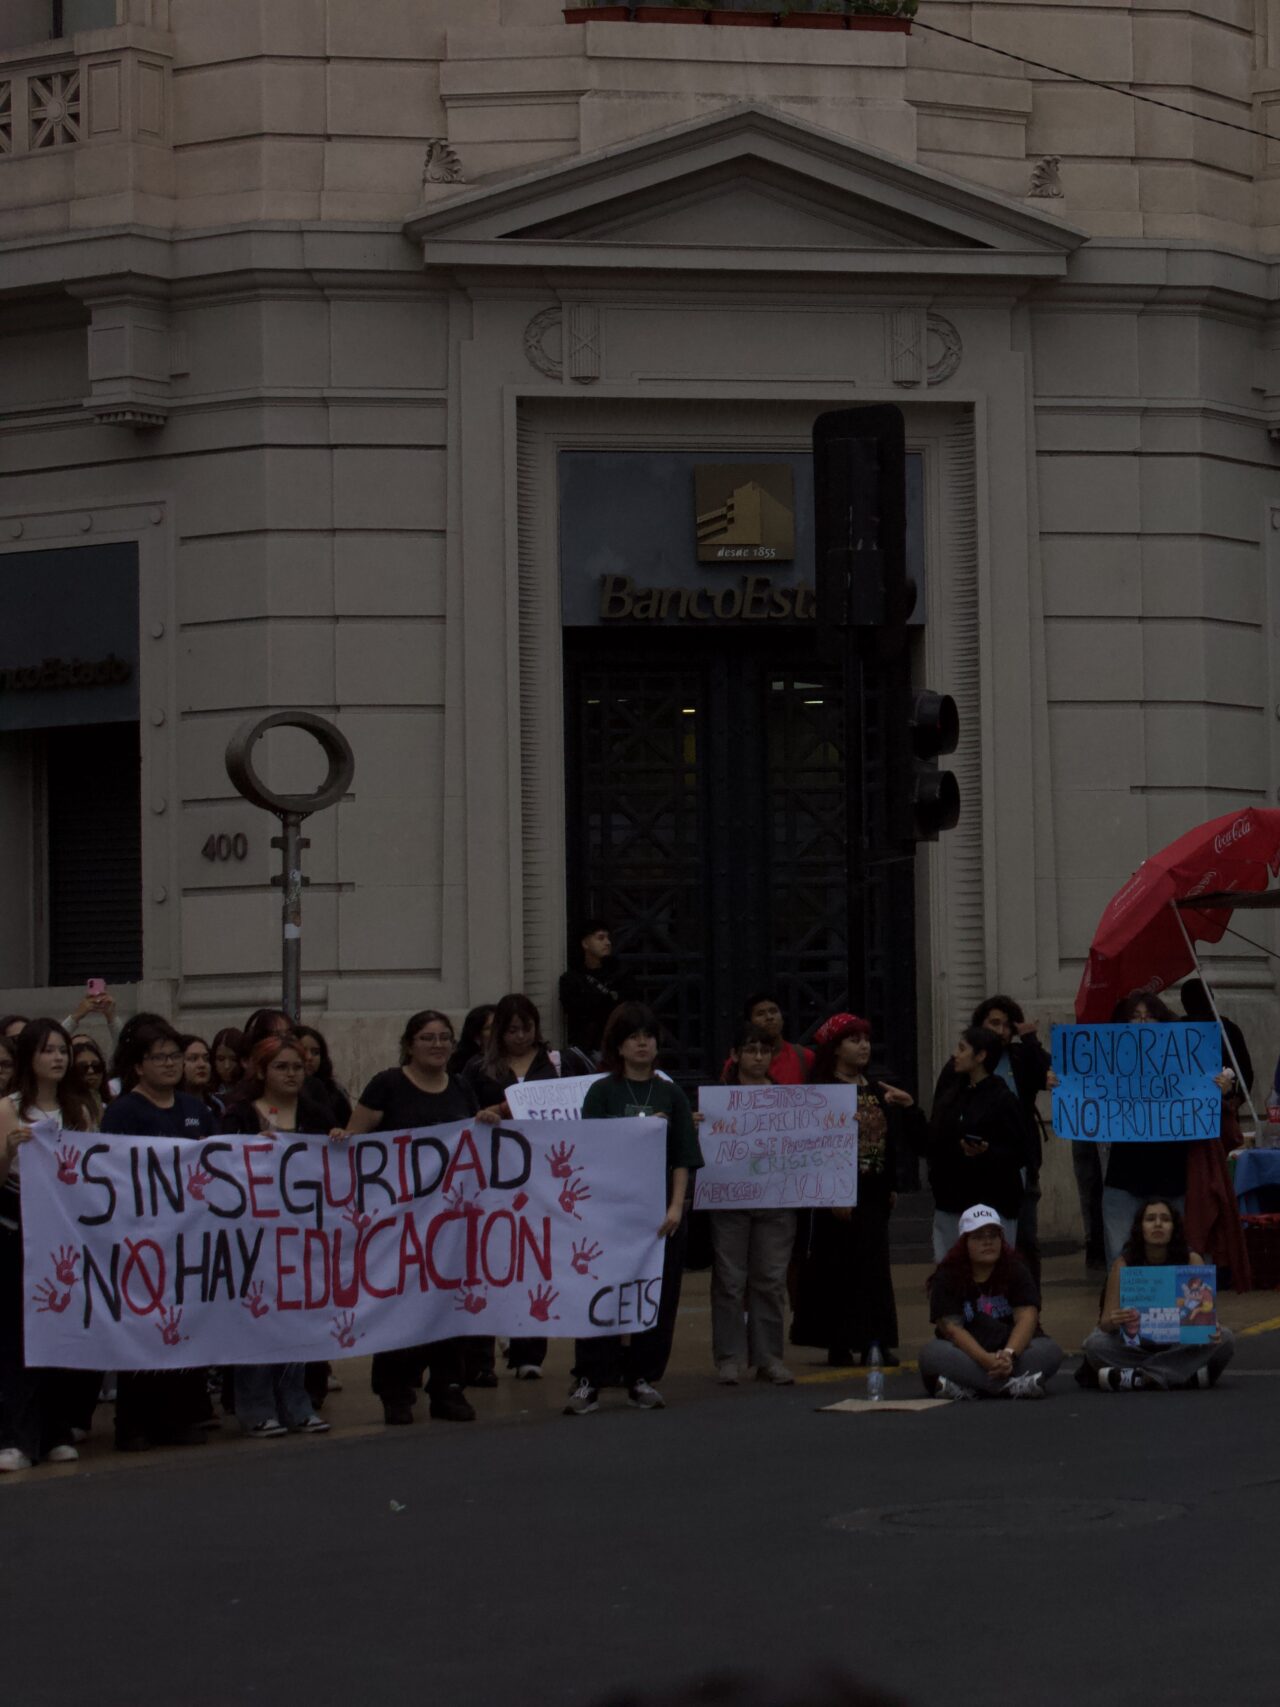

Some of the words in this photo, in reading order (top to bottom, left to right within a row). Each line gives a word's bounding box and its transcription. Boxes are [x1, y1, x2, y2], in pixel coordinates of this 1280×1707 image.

[753, 547, 777, 559] 1855
[201, 832, 248, 861] 400
[1214, 814, 1251, 855] Coca-Cola
[1062, 1028, 1206, 1076] IGNORAR
[727, 1086, 828, 1111] NUESTROS
[1082, 1075, 1109, 1099] ES
[1116, 1074, 1184, 1100] ELEGIR
[741, 1109, 820, 1136] DERECHOS
[1058, 1097, 1100, 1137] NO
[1104, 1098, 1211, 1137] PROTEGER
[715, 1140, 749, 1165] NO
[751, 1137, 778, 1158] SE
[751, 1151, 824, 1175] CRISIS
[78, 1143, 186, 1226] SIN
[200, 1127, 532, 1229] SEGURIDAD
[973, 1210, 993, 1218] UCN
[82, 1237, 167, 1329] NO
[175, 1227, 265, 1305] HAY
[275, 1191, 553, 1311] EDUCACIÓN
[588, 1276, 663, 1328] CETS
